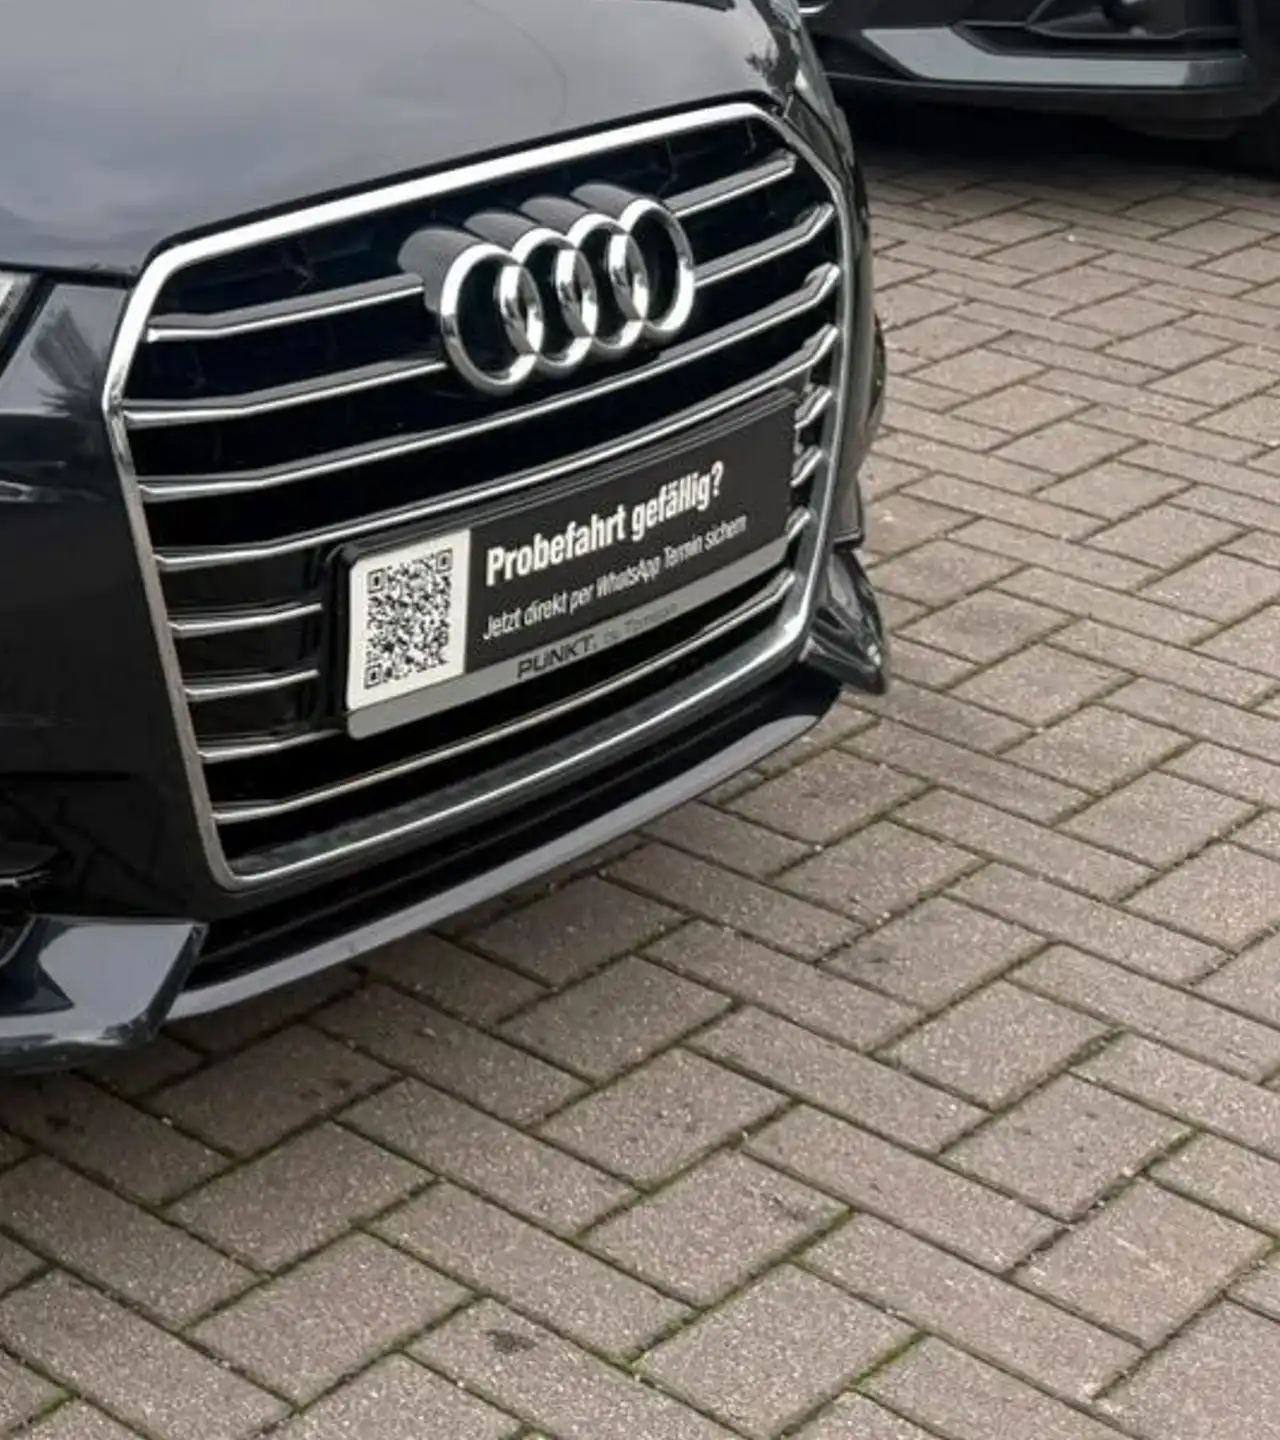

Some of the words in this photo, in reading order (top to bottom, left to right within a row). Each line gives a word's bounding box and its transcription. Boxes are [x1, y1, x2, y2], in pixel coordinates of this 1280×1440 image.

[482, 608, 522, 641] Jetzt
[523, 587, 568, 624] direkt
[569, 582, 595, 615] per
[596, 554, 662, 598] WhatsApp
[663, 532, 704, 569] Termin
[704, 514, 748, 551] sichern
[486, 503, 627, 587] Probefahrt
[631, 460, 725, 542] gefällig?
